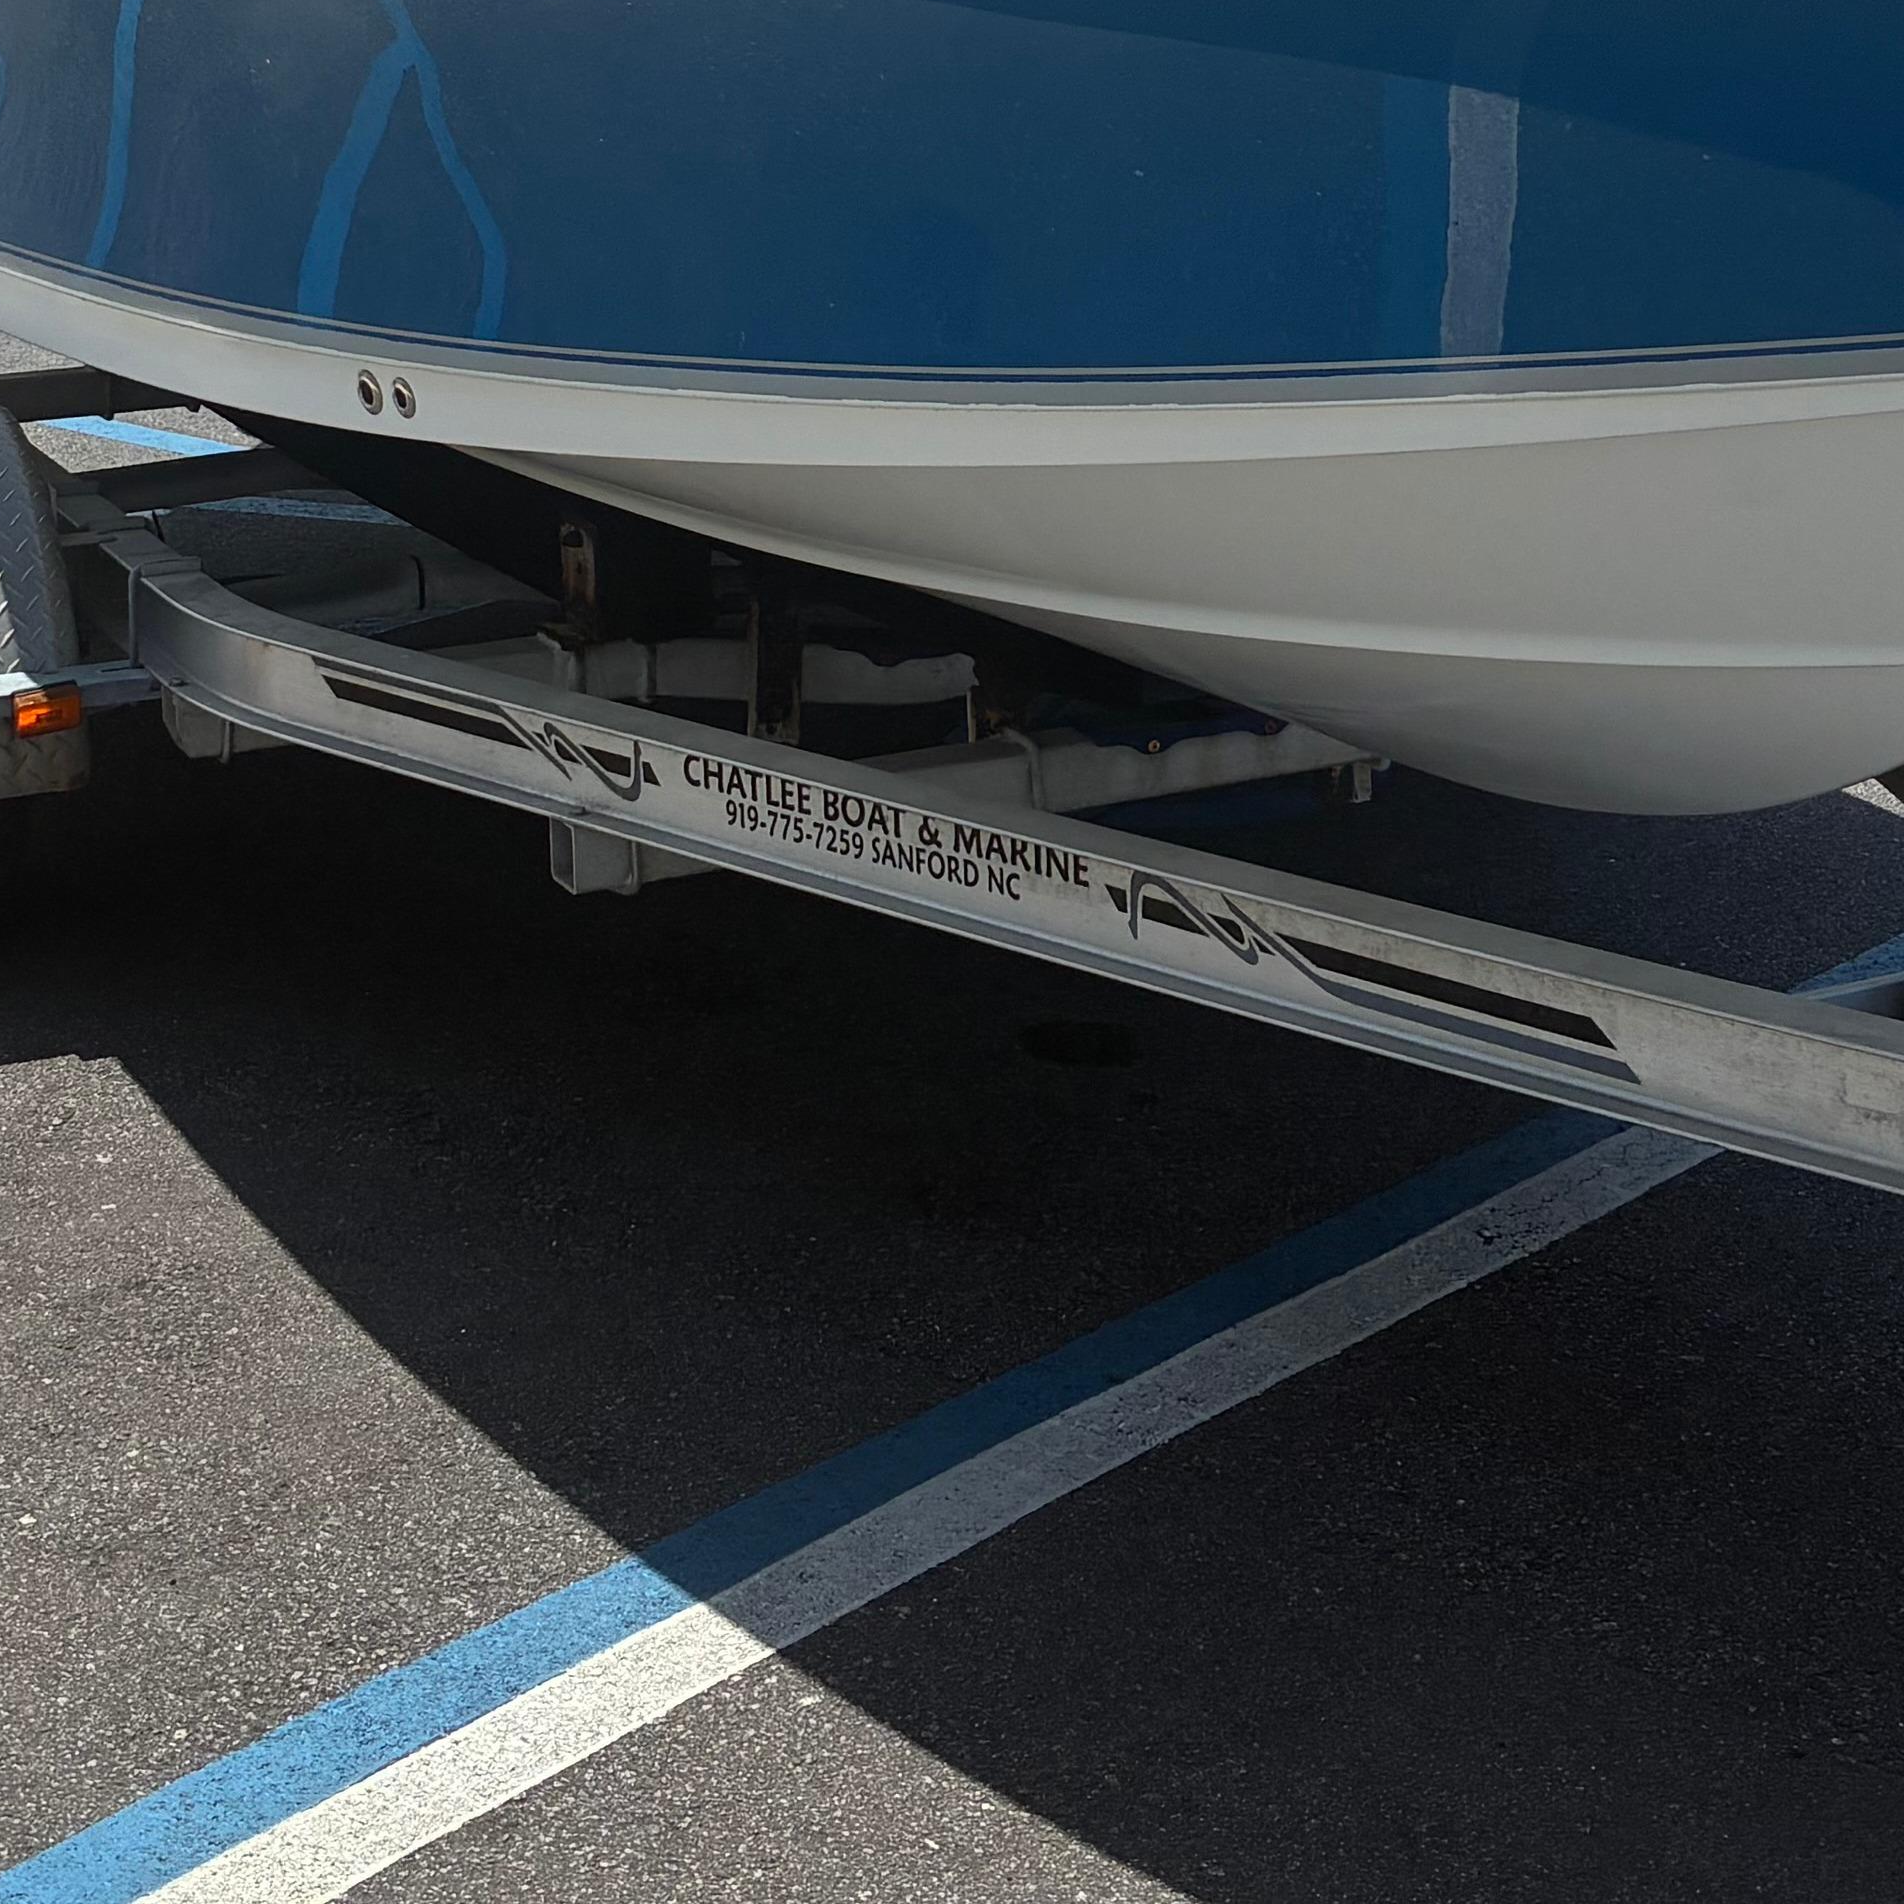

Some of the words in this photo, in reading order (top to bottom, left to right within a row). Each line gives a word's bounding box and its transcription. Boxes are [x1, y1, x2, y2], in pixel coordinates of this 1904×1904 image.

[683, 754, 812, 817] CHATLEE
[823, 786, 906, 840] BOAT
[918, 815, 943, 848] &
[953, 823, 1091, 888] MARINE
[725, 798, 865, 860] 919-775-7259
[871, 837, 980, 888] SANFORD
[987, 865, 1022, 901] NC
